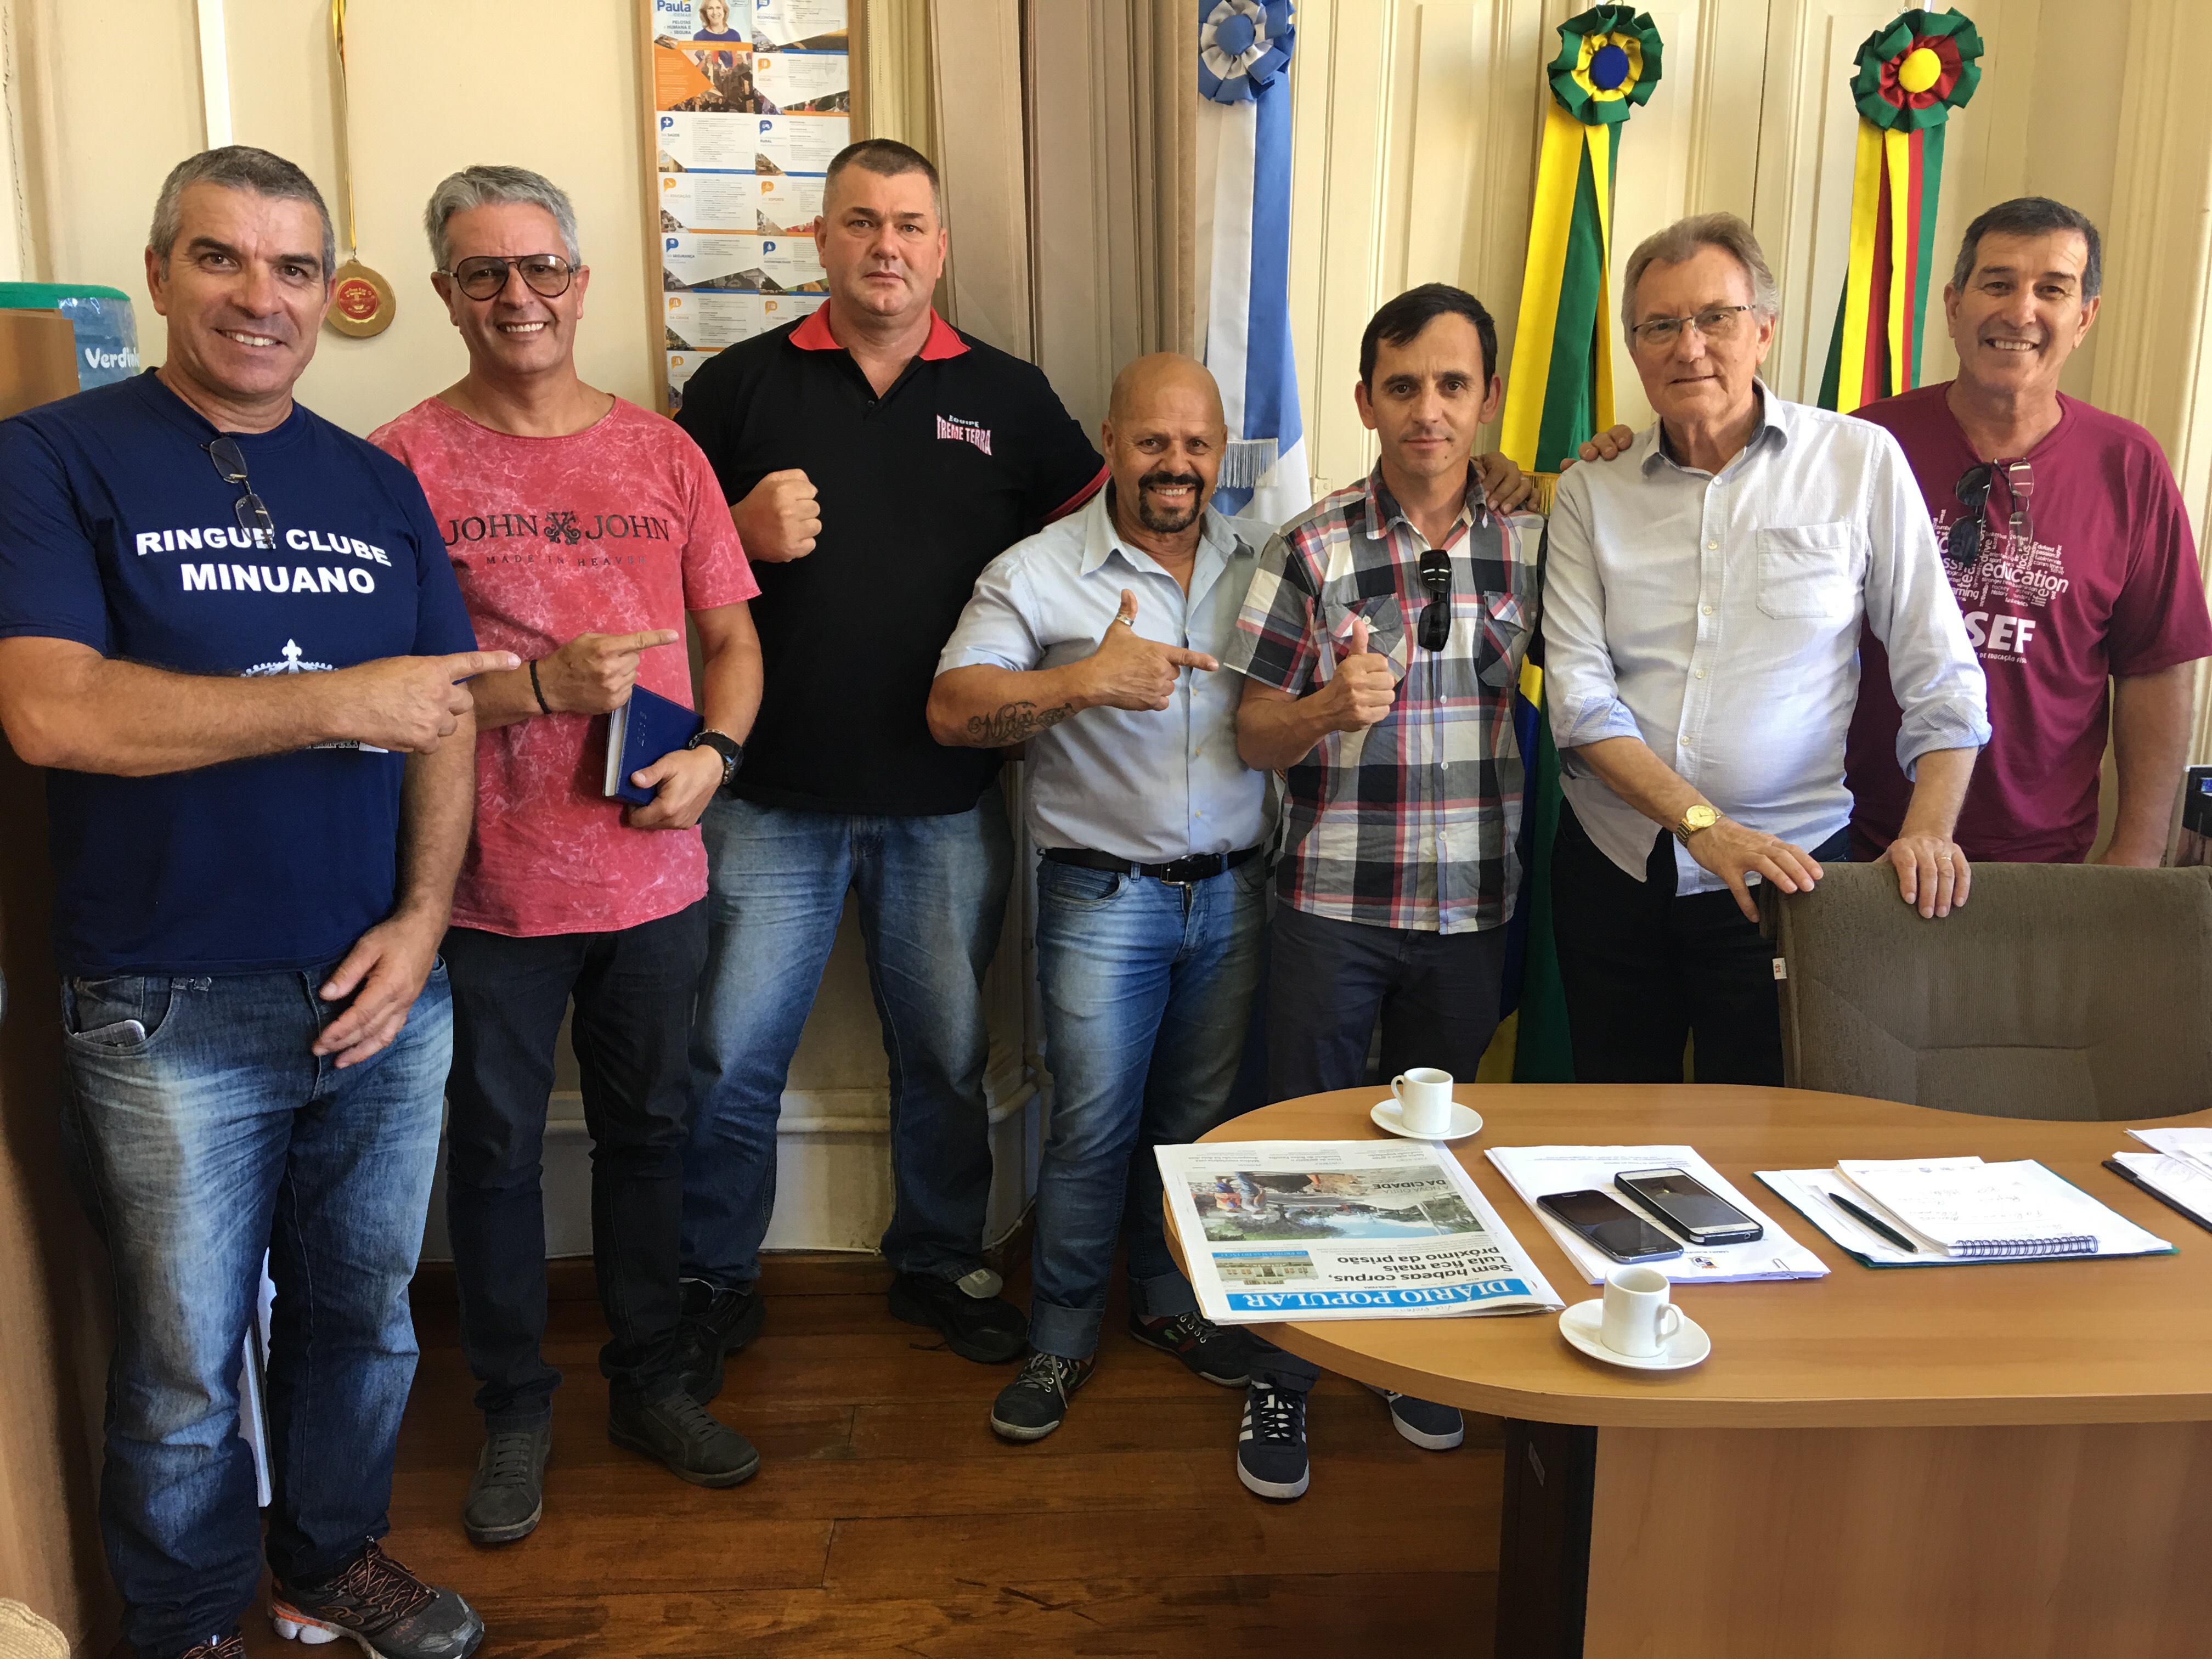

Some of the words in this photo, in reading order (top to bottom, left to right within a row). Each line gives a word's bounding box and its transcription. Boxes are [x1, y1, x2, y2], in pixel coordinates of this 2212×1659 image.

[657, 0, 691, 13] Paula
[949, 414, 979, 428] EQUIPE
[936, 413, 964, 441] TREME
[964, 427, 992, 456] TERRA
[442, 514, 538, 546] JOHN
[585, 514, 670, 541] JOHN
[286, 528, 392, 567] CLUBE
[1979, 539, 1993, 562] drive
[487, 554, 535, 565] MADE
[578, 556, 647, 567] HEAVEN
[2016, 545, 2031, 570] focus
[180, 563, 375, 594] MINUANO
[1982, 561, 2069, 594] education
[2030, 588, 2050, 607] life
[1960, 610, 2036, 653] SEF
[1988, 653, 2015, 662] EDUCAÇÃO
[1372, 1181, 1424, 1189] CIDADE
[1337, 1254, 1395, 1265] prisão
[1426, 1246, 1500, 1260] próximo
[1383, 1264, 1426, 1273] mais
[1430, 1259, 1465, 1268] fica
[1471, 1264, 1513, 1273] Sem
[1328, 1273, 1396, 1282] corpus,
[1401, 1268, 1468, 1280] habeas
[1400, 1280, 1513, 1302] DIÁRIO
[1242, 1291, 1395, 1307] POPULAR
